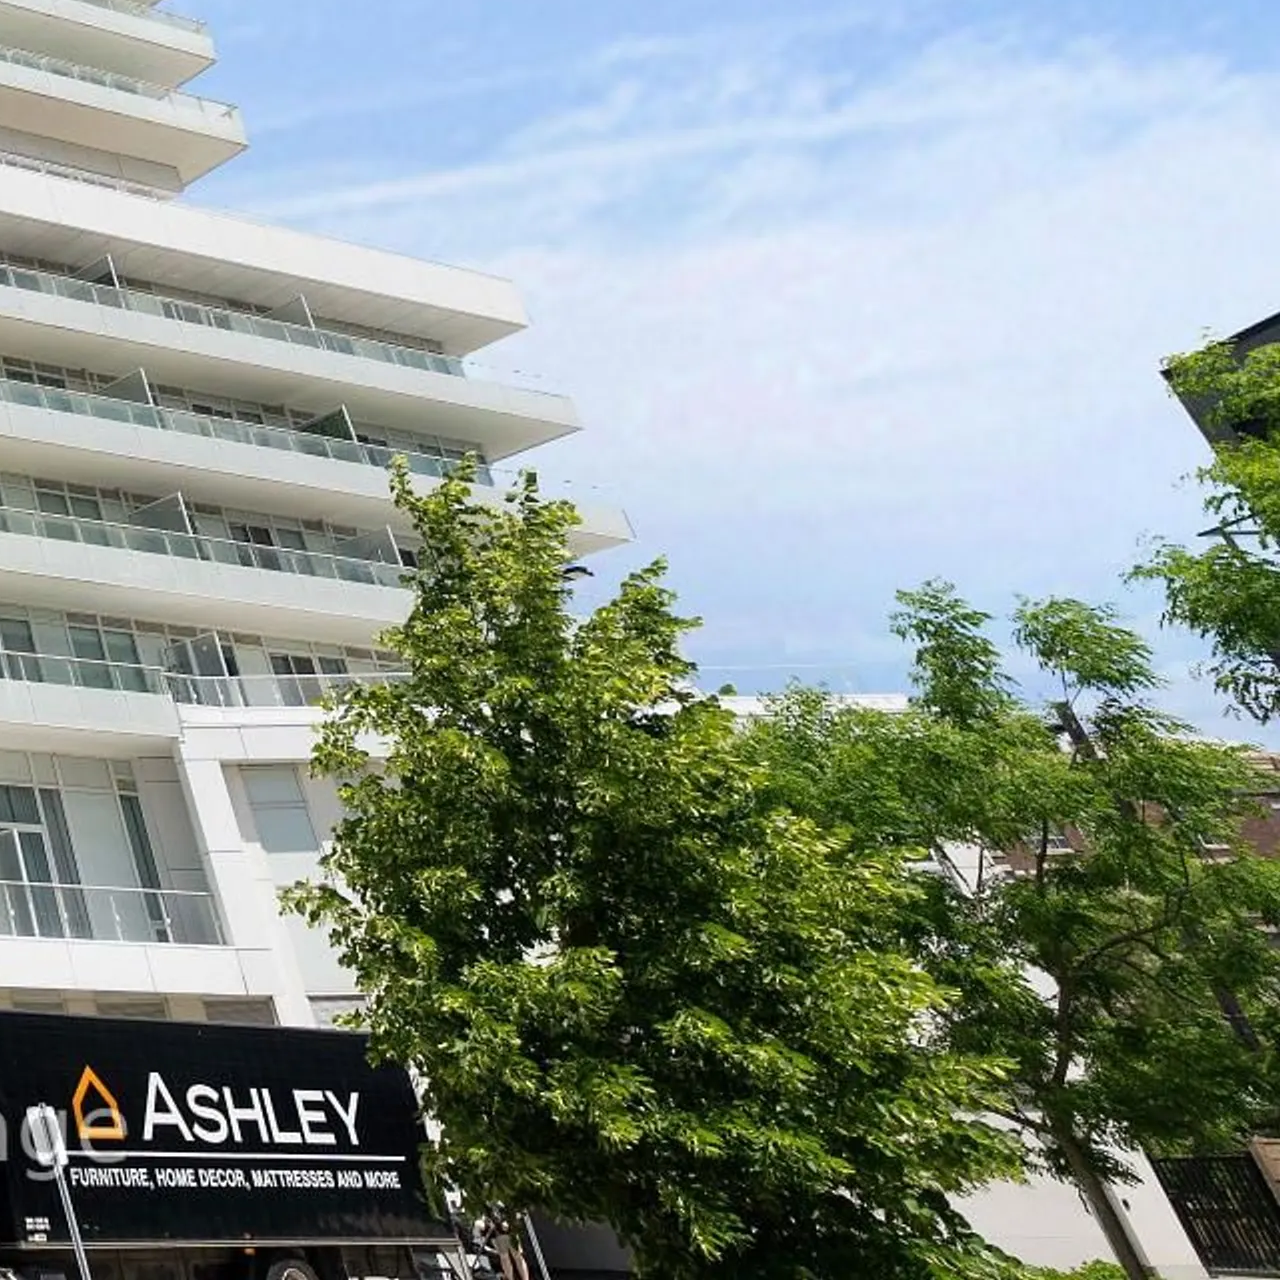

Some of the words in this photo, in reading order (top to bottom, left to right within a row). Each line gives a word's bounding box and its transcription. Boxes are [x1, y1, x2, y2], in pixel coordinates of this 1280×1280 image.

[142, 1071, 360, 1146] ASHLEY
[70, 1167, 155, 1191] FURNITURE,
[156, 1168, 197, 1188] HOME
[198, 1168, 252, 1191] DECOR,
[252, 1170, 335, 1189] MATTRESSES
[336, 1170, 364, 1189] AND
[364, 1170, 402, 1189] MORE
